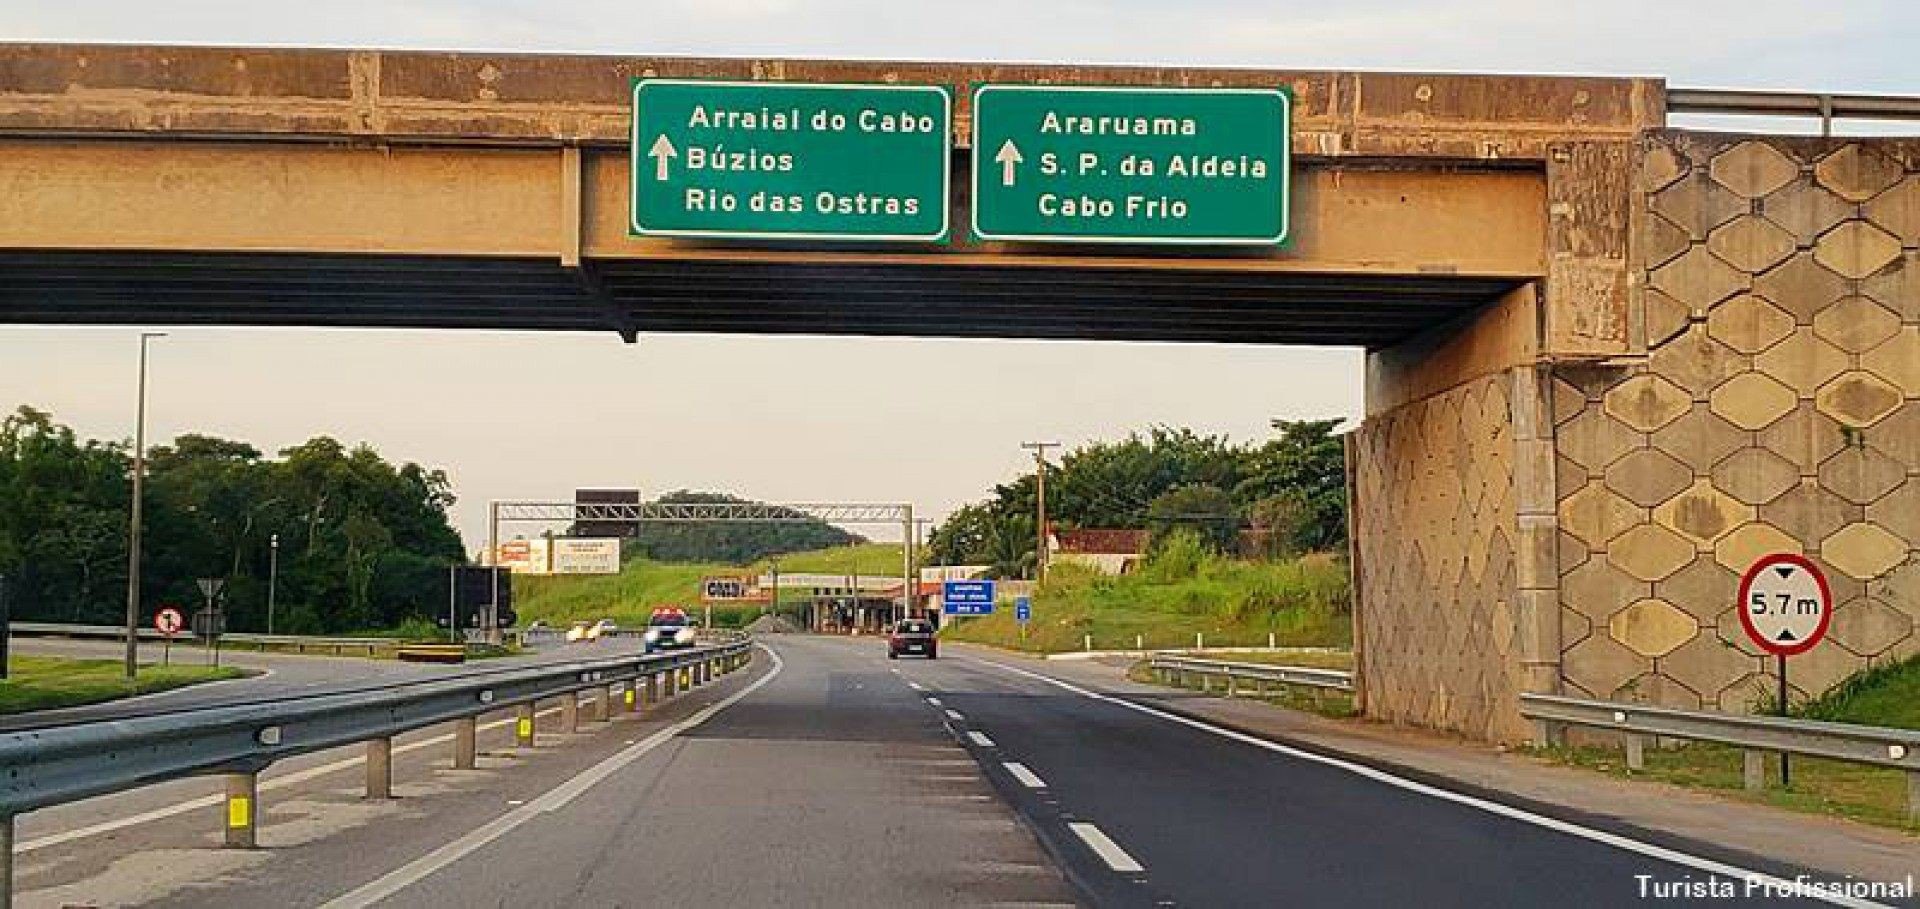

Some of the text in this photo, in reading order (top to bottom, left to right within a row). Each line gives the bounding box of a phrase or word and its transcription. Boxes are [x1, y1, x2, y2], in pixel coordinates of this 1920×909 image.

[688, 106, 934, 133] Arraial do Cabo
[1041, 111, 1196, 135] Araruama
[687, 144, 793, 171] Búzios
[1041, 154, 1267, 178] S. P. da Aldeia
[686, 188, 919, 215] Rio das Ostras
[1038, 194, 1187, 218] Cabo Frio
